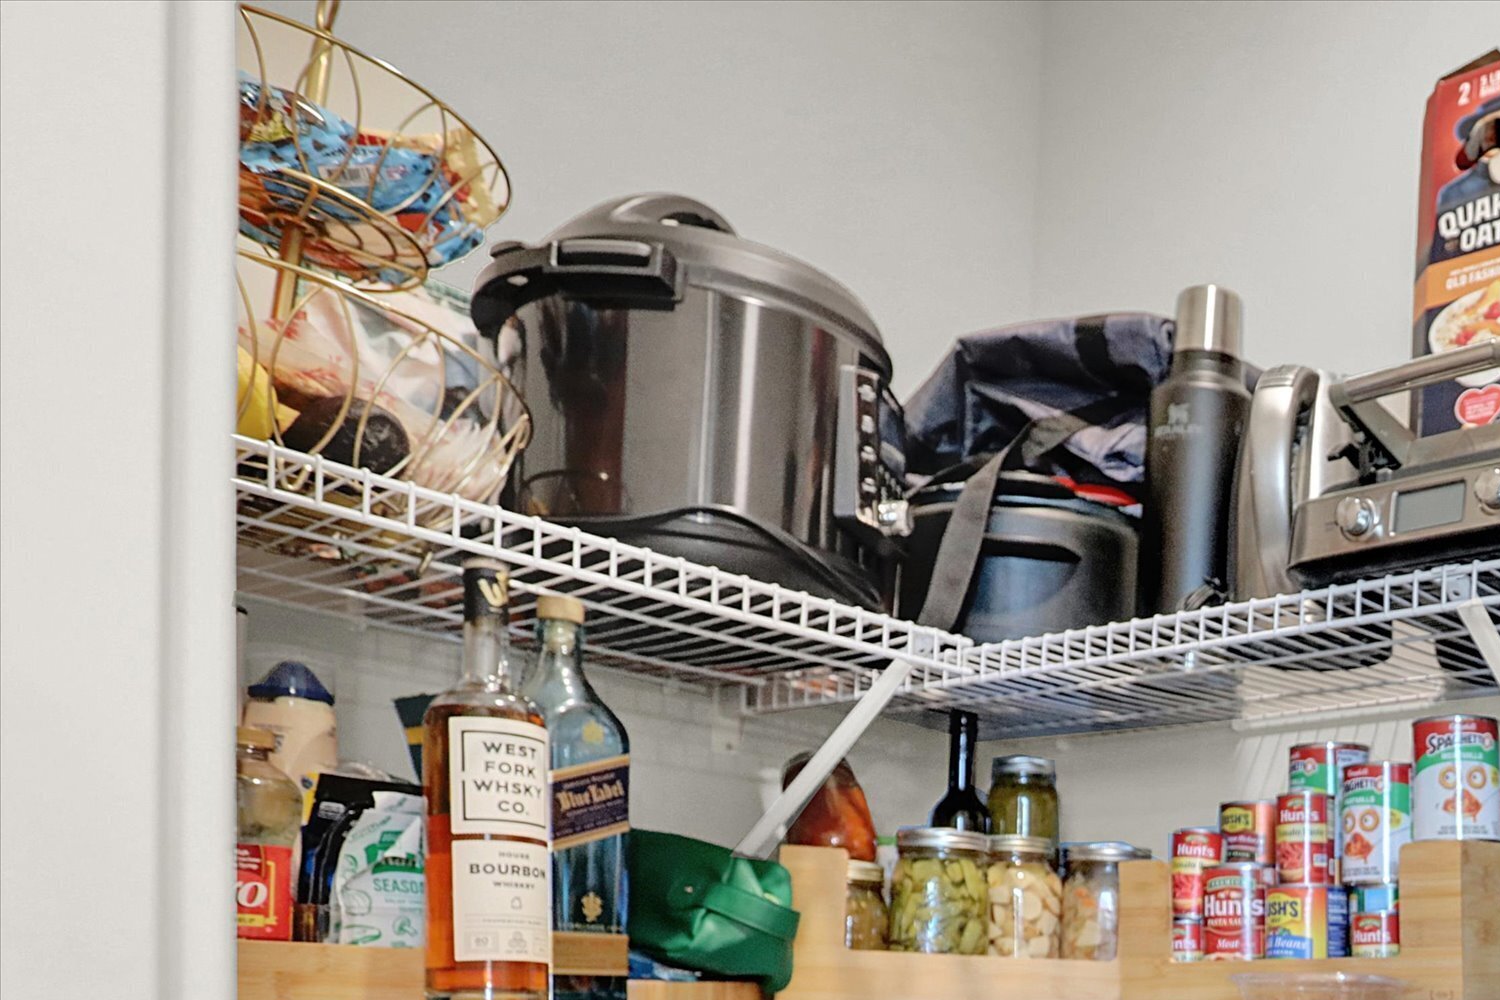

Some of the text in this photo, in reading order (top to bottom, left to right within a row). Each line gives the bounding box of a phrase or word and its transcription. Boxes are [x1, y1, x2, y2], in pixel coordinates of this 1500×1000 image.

[1446, 274, 1468, 291] OLD
[483, 741, 538, 760] WEST
[485, 761, 536, 779] FORK
[473, 780, 543, 799] WHSKY
[497, 800, 530, 817] CO.
[469, 864, 547, 880] BOURBON
[1204, 894, 1264, 917] Hun's
[1267, 901, 1299, 917] USH'S
